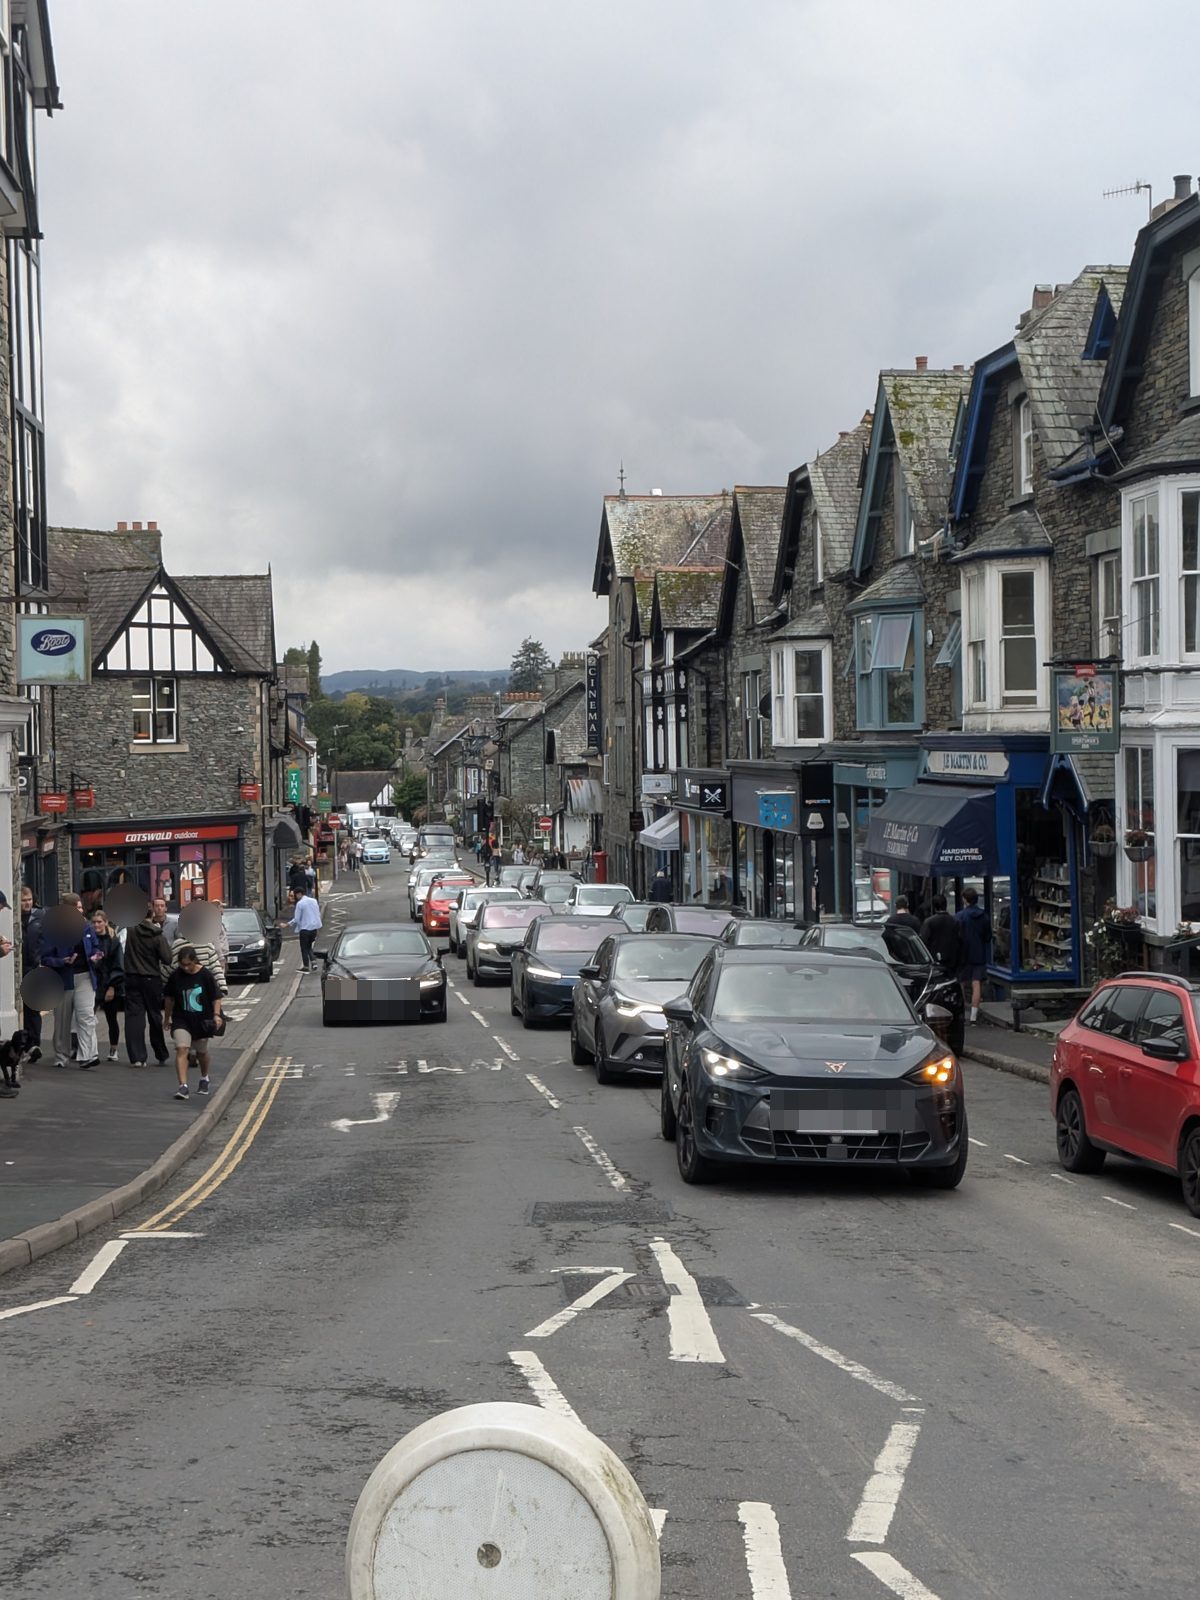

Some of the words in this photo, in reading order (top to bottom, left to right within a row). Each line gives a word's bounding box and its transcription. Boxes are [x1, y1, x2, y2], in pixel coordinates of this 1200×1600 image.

[37, 634, 71, 651] Boots
[588, 667, 598, 732] CINEMA
[125, 831, 172, 842] COTSWOLD
[174, 831, 198, 839] outdoor
